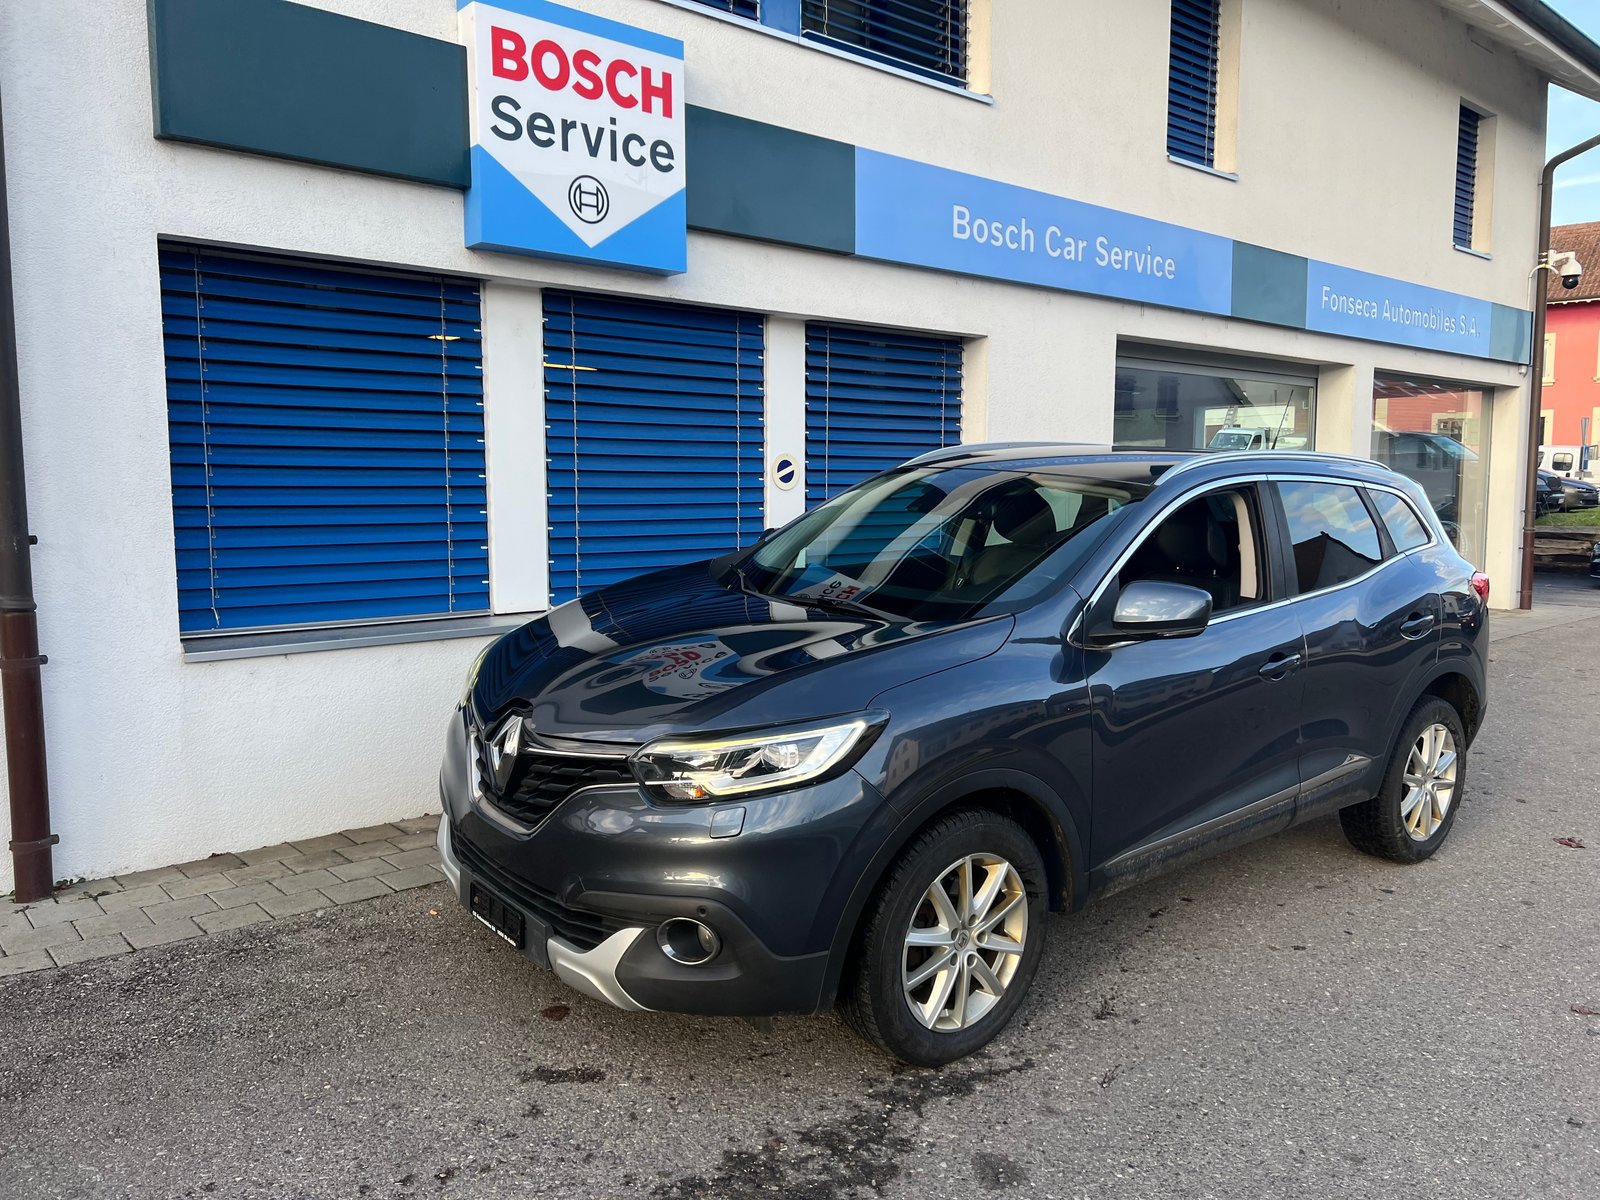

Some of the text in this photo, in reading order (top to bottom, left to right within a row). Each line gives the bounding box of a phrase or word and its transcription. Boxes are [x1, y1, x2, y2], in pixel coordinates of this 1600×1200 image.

[491, 25, 673, 119] BOSCH
[490, 94, 675, 173] Service
[952, 204, 1176, 280] Bosch Car Service
[1322, 286, 1481, 338] Fonseca Automobiles S.A.
